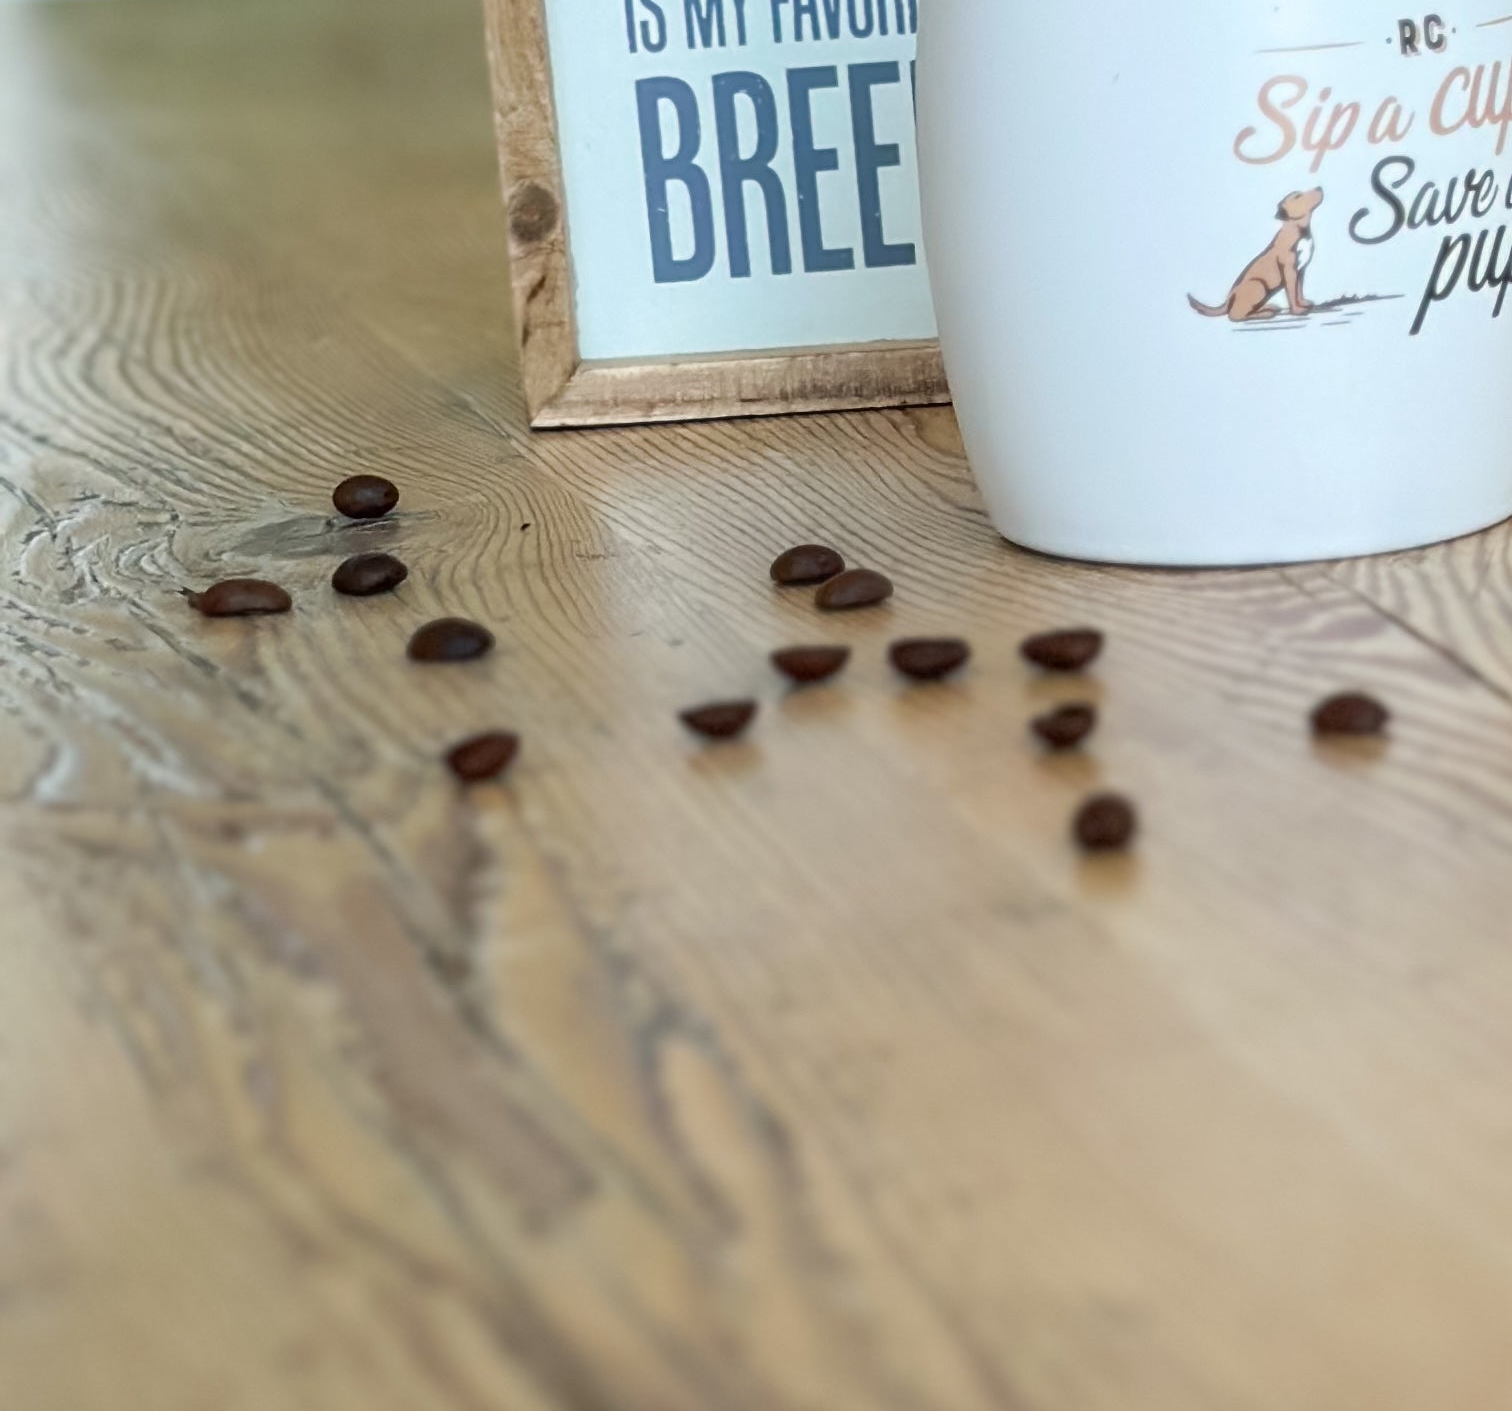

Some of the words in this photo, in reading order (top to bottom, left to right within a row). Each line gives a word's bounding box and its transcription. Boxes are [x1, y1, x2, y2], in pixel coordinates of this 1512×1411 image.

[1397, 13, 1446, 56] RC
[1233, 74, 1362, 174] Sip
[1366, 95, 1416, 145] a
[635, 60, 918, 285] BREE
[1348, 155, 1499, 246] Save
